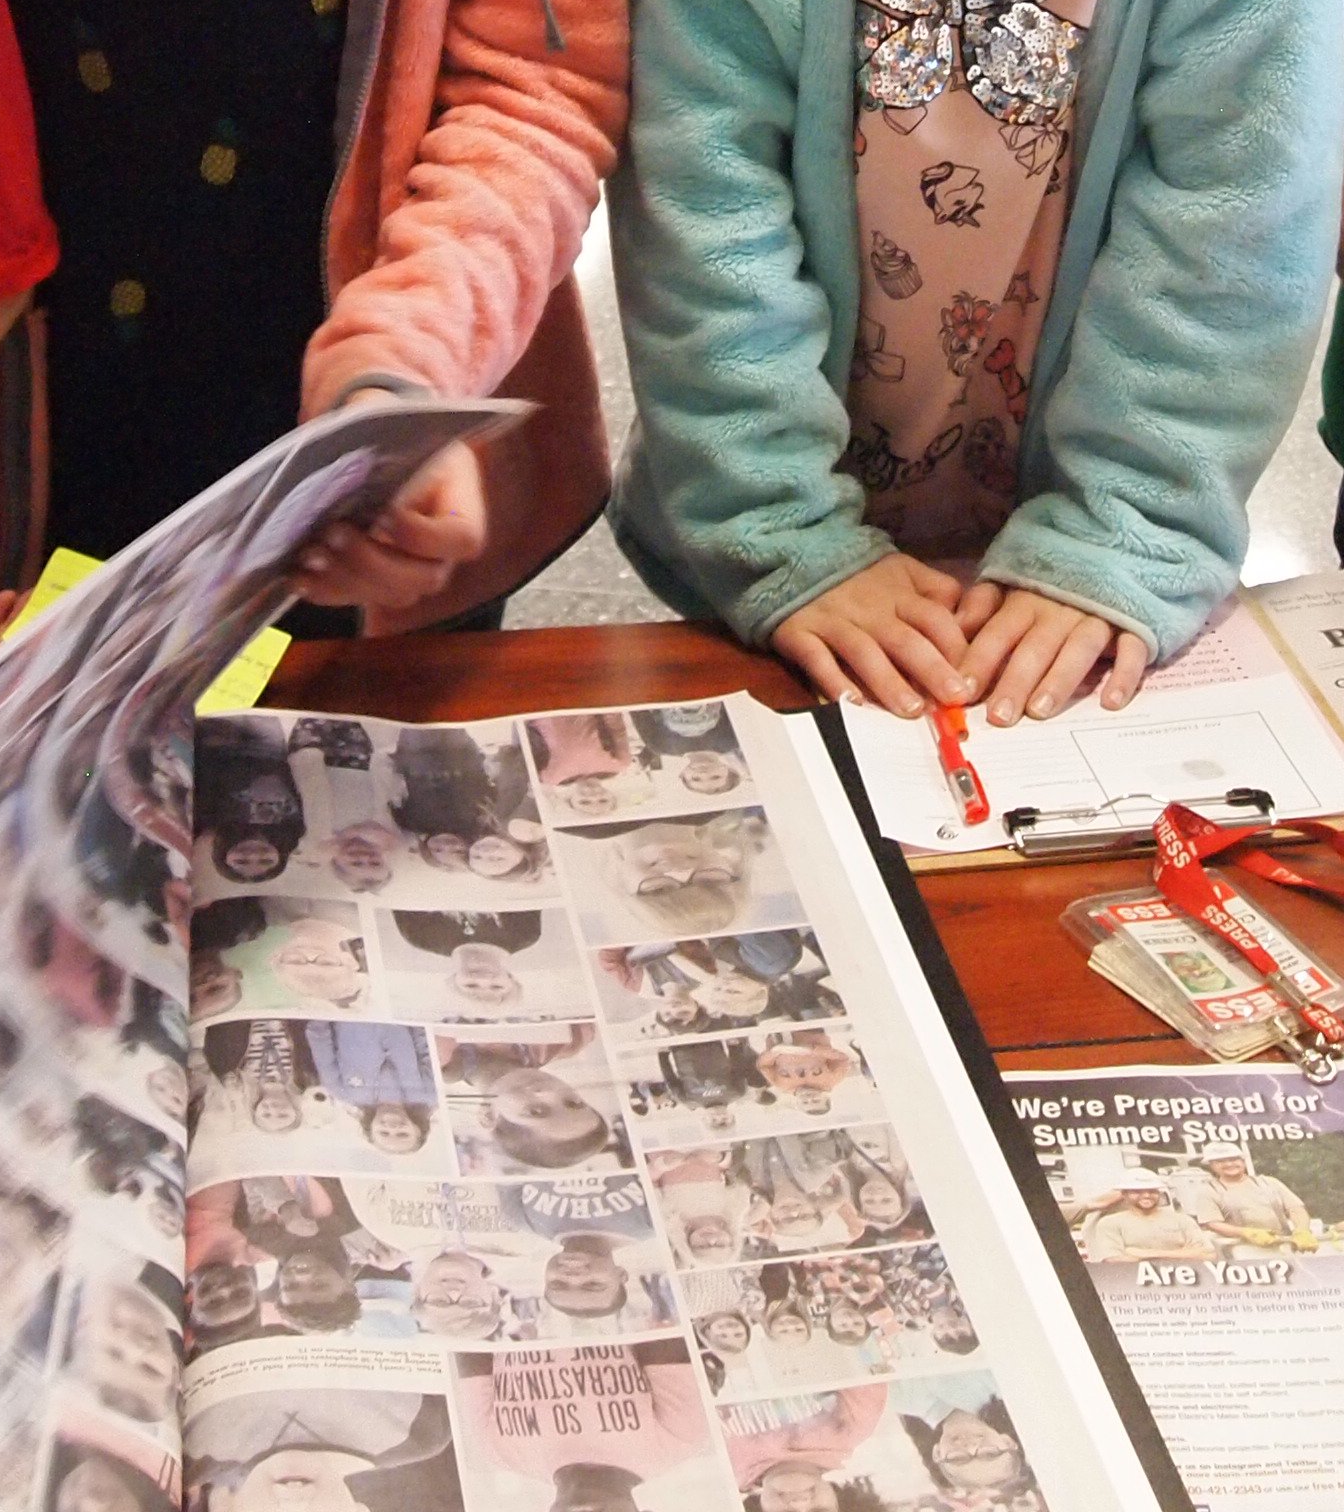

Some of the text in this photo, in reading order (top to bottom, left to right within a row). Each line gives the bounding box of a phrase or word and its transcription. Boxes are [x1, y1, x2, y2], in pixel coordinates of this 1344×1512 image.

[1201, 904, 1260, 951] PRESS
[1012, 1091, 1320, 1120] We're Prepared for
[1033, 1119, 1314, 1147] Summer Storms.
[1136, 1259, 1290, 1286] Are You?
[1244, 1285, 1282, 1299] family
[1285, 1284, 1341, 1297] minimize
[553, 1403, 582, 1436] SO
[598, 1400, 641, 1432] GOT
